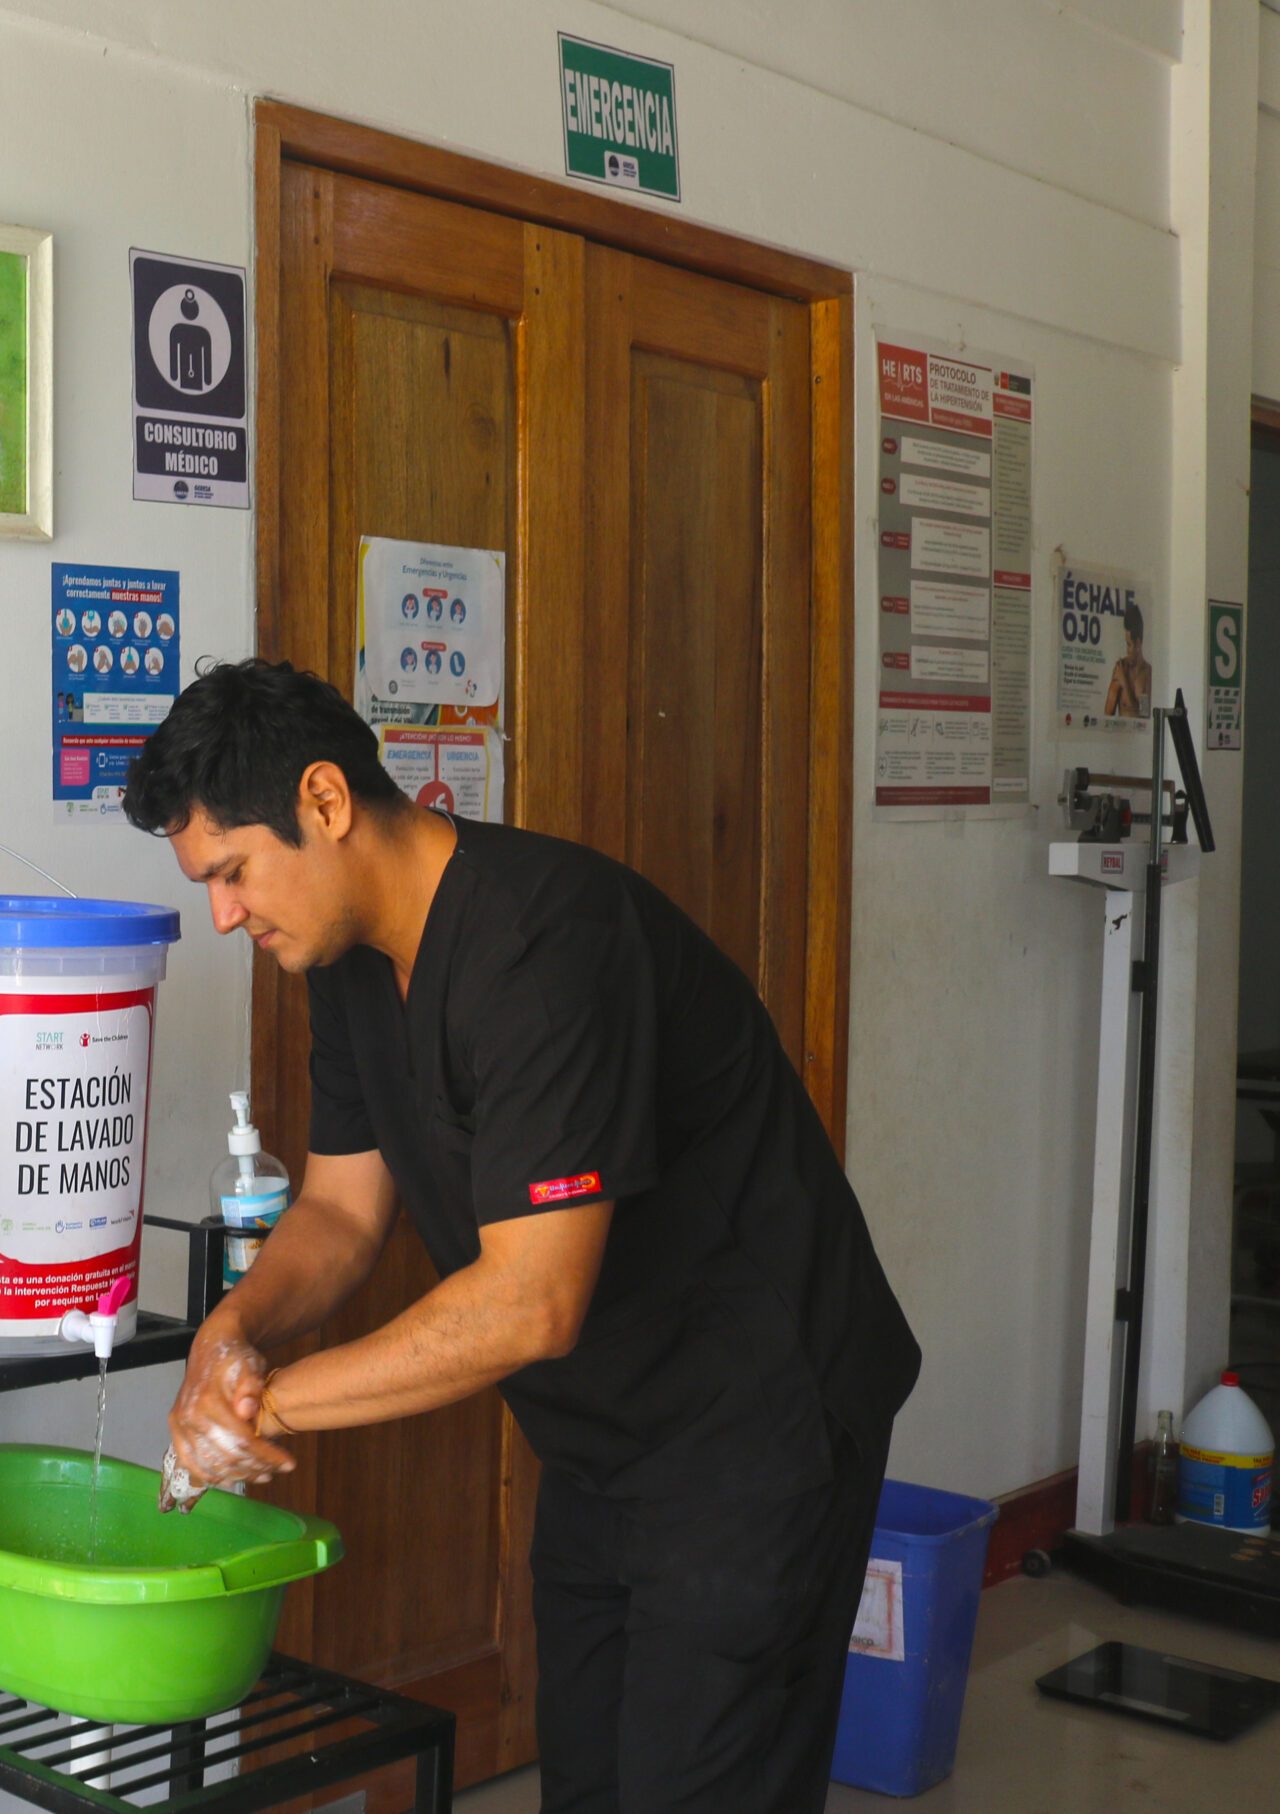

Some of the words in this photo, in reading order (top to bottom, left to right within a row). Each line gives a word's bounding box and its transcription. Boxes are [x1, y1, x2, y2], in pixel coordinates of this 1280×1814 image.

[564, 68, 673, 156] EMERGENCIA
[929, 363, 976, 384] PROTOCOLO
[930, 379, 938, 388] DE
[940, 380, 979, 397] TRATAMIENTO
[981, 389, 989, 400] DE
[931, 392, 938, 402] LA
[940, 394, 982, 412] HIPERTENSIÓN
[144, 423, 236, 450] CONSULTORIO
[166, 450, 218, 475] MÉDICO
[1063, 571, 1136, 617] ÉCHALE
[1063, 612, 1101, 645] OJO
[1215, 616, 1237, 679] S
[25, 1067, 131, 1110] ESTACIÓN
[15, 1121, 47, 1152] DE
[58, 1114, 134, 1151] LAVADO
[17, 1164, 50, 1195] DE
[59, 1156, 130, 1194] MANOS
[4, 1287, 12, 1295] la
[71, 1280, 108, 1292] Respuesta
[45, 1272, 83, 1282] donación
[85, 1269, 110, 1280] gratuita
[35, 1299, 50, 1308] por
